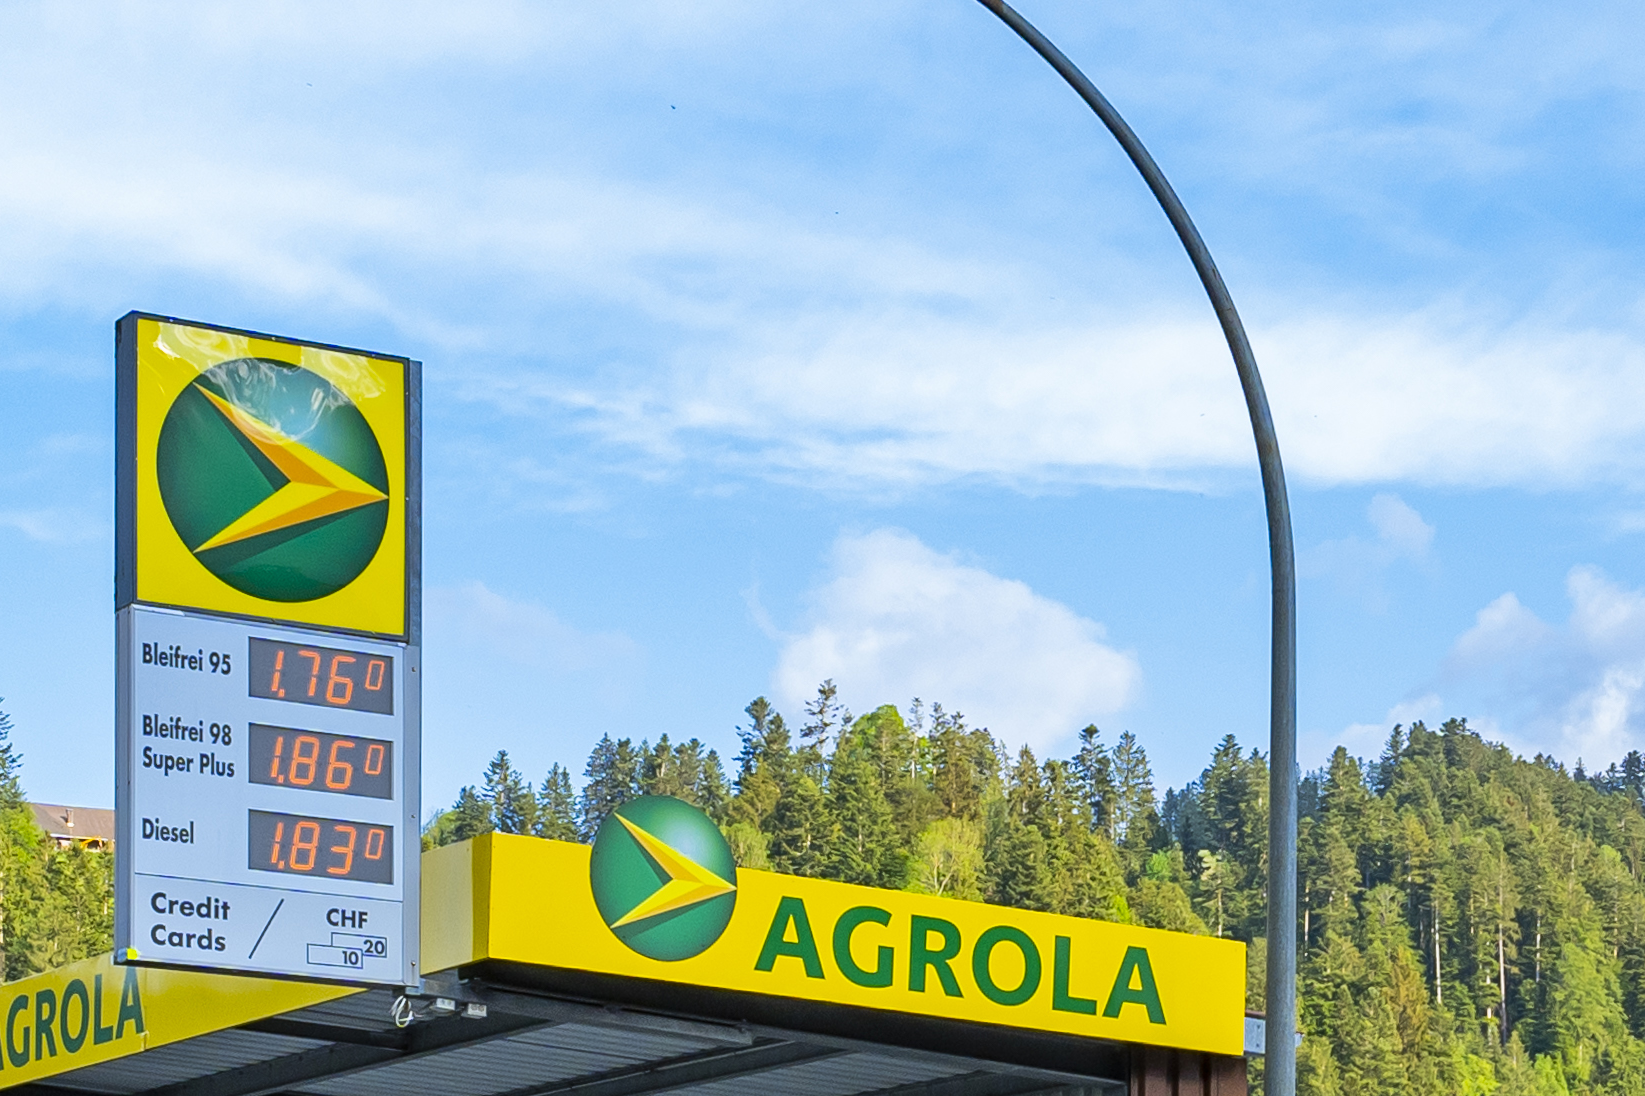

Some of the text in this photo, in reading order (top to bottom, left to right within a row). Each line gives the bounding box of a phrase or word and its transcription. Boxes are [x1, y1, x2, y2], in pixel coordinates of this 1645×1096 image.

[141, 642, 232, 675] Bleifrei 95
[141, 713, 233, 747] Bleifrei 98
[141, 745, 236, 778] Super Plus
[141, 817, 195, 845] Diesel
[150, 890, 231, 921] Credit
[325, 907, 369, 929] CHF
[150, 923, 227, 952] Cards
[363, 938, 386, 955] 20
[341, 950, 360, 966] 10
[753, 895, 1167, 1026] AGROLA
